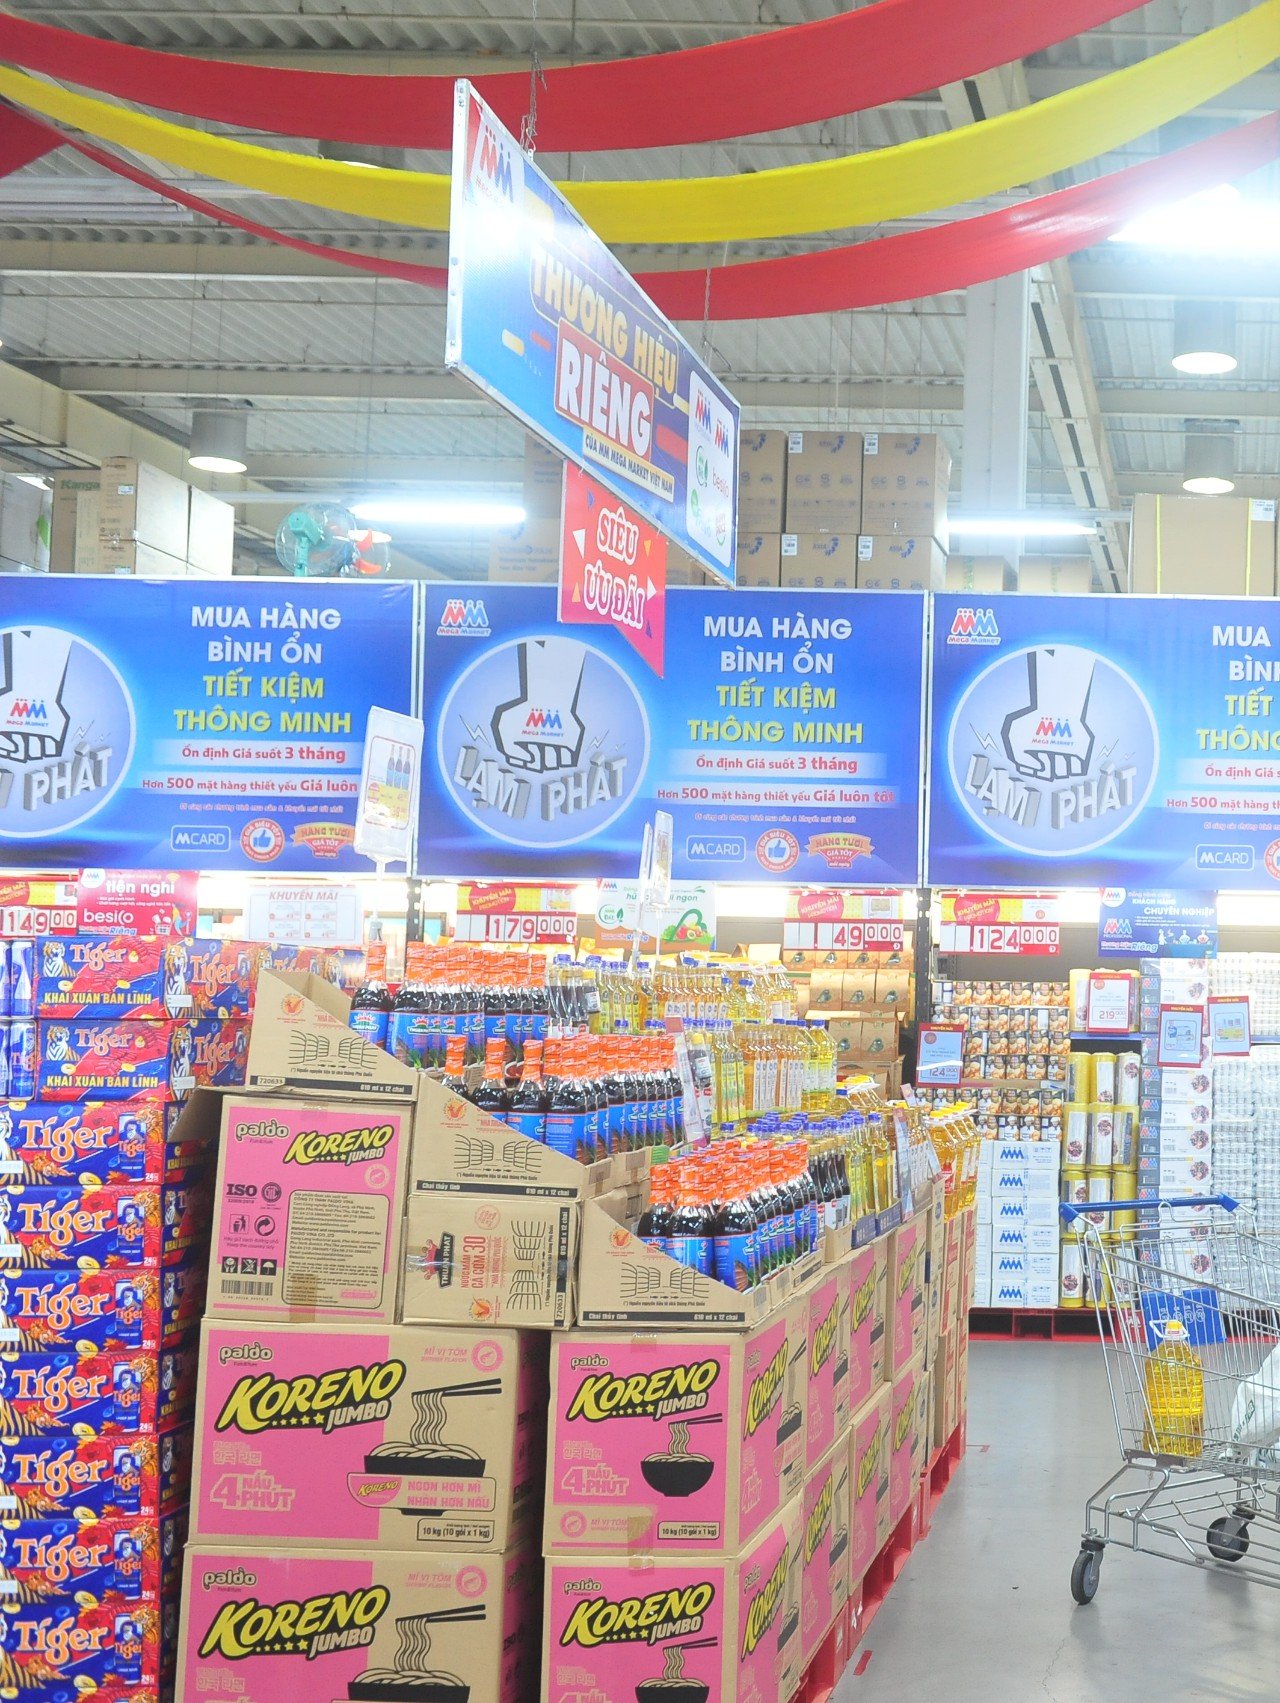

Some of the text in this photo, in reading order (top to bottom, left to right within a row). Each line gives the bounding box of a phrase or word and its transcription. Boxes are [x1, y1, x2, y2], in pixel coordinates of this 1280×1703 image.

[559, 339, 651, 457] RIÊNG
[597, 508, 638, 568] SIÊU
[191, 602, 342, 631] MUA HÀNG
[703, 611, 852, 640] MUA HÀNG
[208, 632, 322, 663] BÌNH ỔN
[1212, 625, 1271, 647] MUA
[720, 641, 834, 674] BÌNH ỔN
[203, 668, 324, 703] TIẾT KIỆM
[716, 677, 836, 715] TIẾT KIỆM
[1225, 686, 1273, 717] TIẾT
[174, 705, 351, 734] THÔNG MINH
[687, 714, 863, 744] THÔNG MINH
[1255, 766, 1274, 778] Giá
[1191, 796, 1218, 809] 500
[141, 880, 174, 897] nghi
[70, 944, 127, 971] Tiger
[190, 953, 235, 995] Tiger
[44, 992, 68, 1004] KHAI
[71, 992, 101, 1004] XUÂN
[75, 1027, 133, 1055] Tiger
[19, 1117, 113, 1162] Tiger
[236, 1119, 290, 1141] paldo
[284, 1125, 394, 1165] KORENO
[346, 1146, 386, 1166] JUMBO
[226, 1184, 258, 1198] ISO
[16, 1200, 112, 1245] Tiger
[219, 1342, 273, 1366] paldo
[215, 1359, 407, 1434] KORENO
[324, 1399, 391, 1434] JUMBO
[12, 1618, 108, 1665] Tiger
